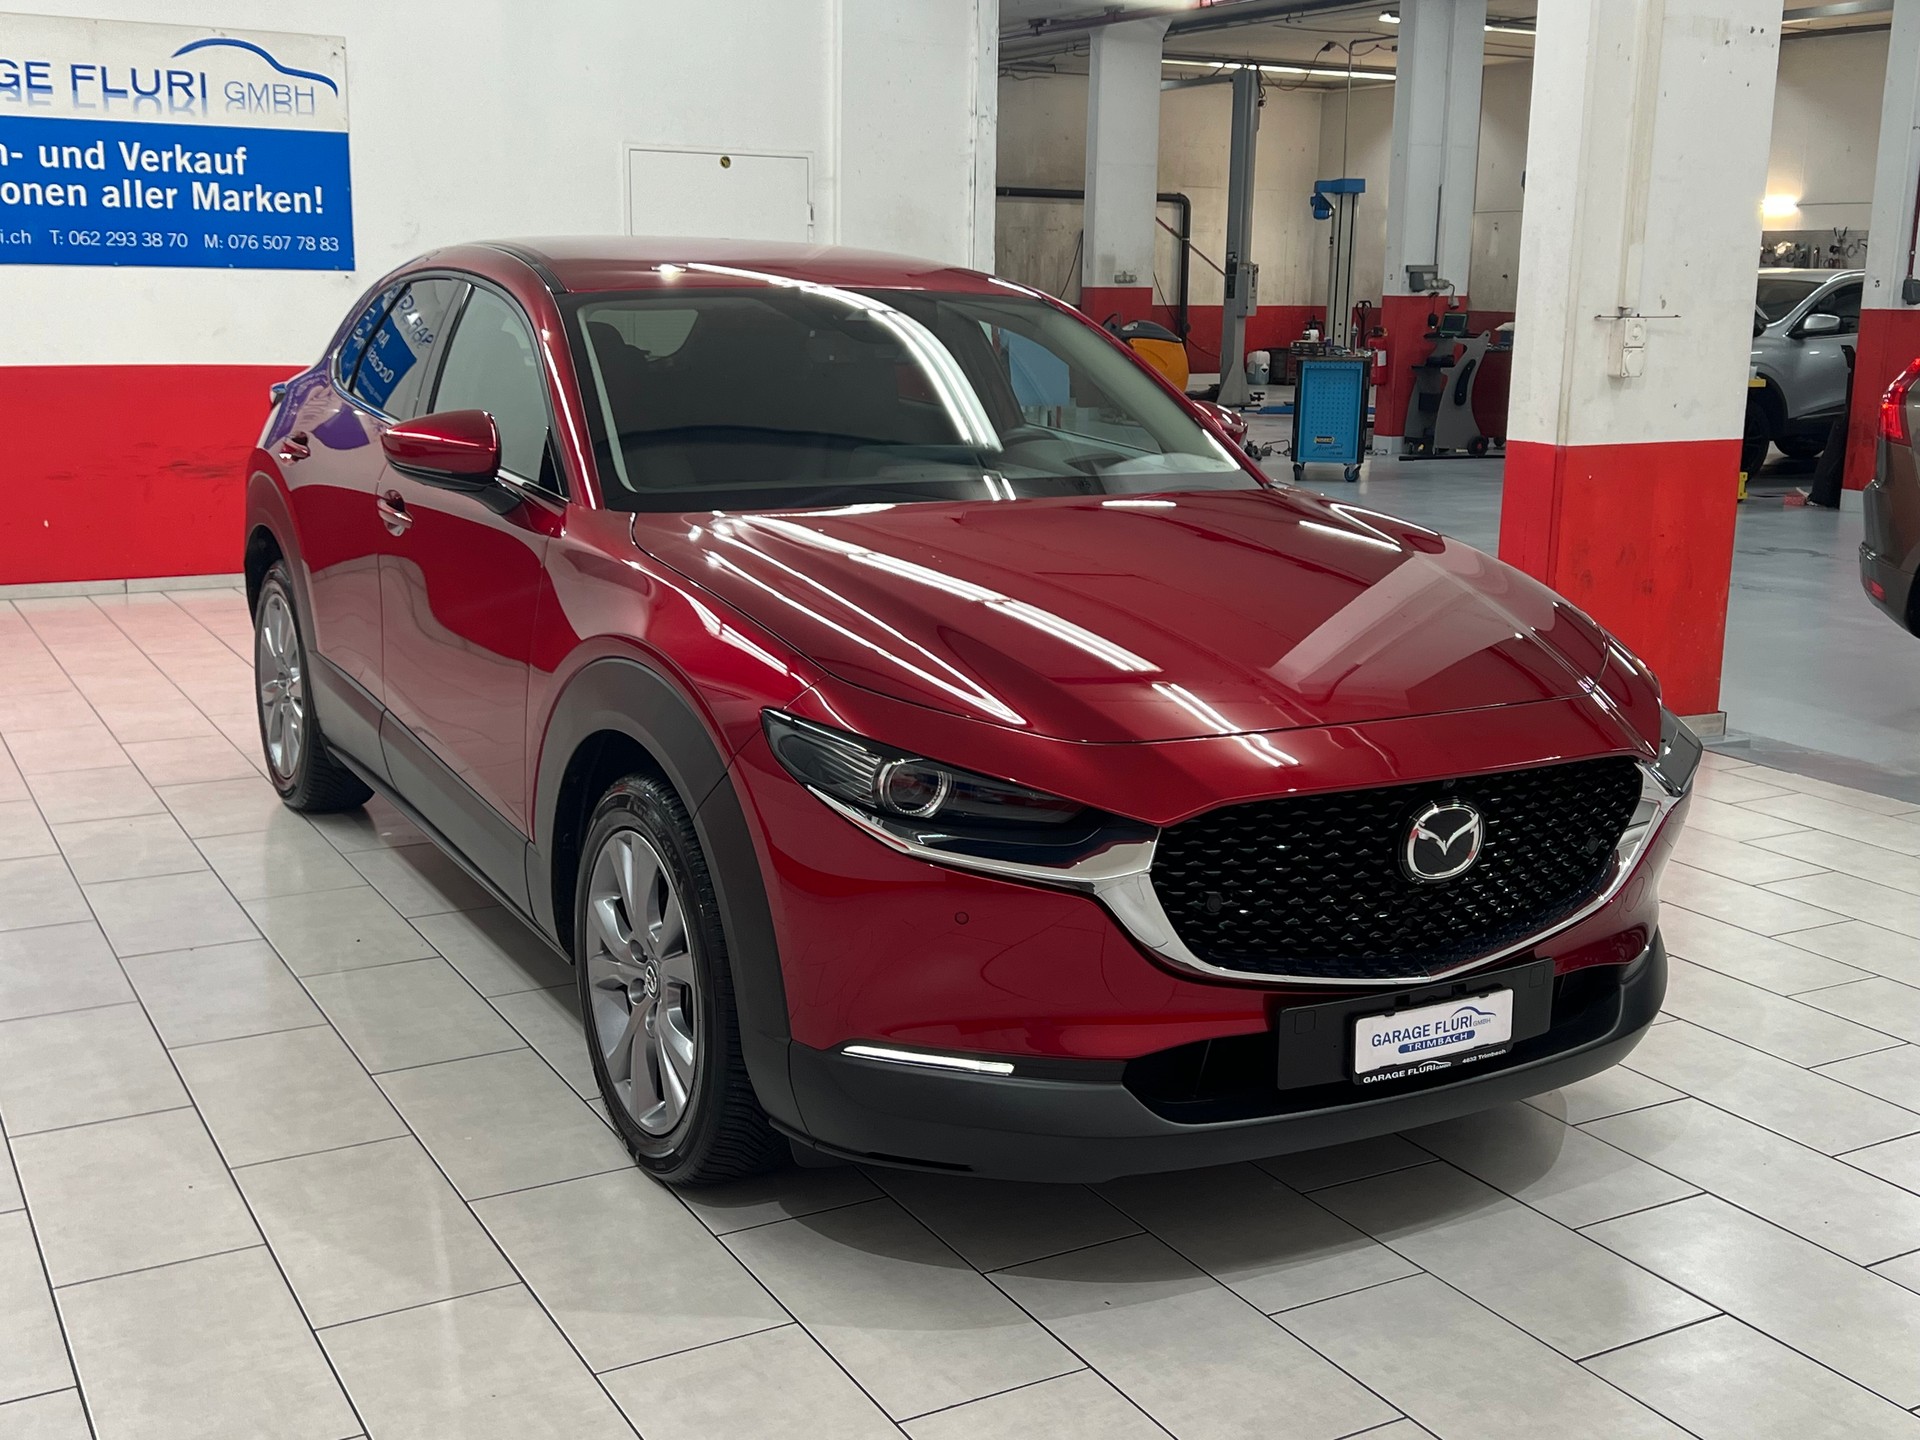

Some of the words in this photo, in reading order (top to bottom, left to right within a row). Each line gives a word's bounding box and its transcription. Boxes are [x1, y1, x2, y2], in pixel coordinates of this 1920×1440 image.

[70, 64, 208, 99] FLURI
[223, 80, 316, 102] GMBH
[38, 140, 106, 170] und
[118, 141, 248, 175] Verkauf
[0, 181, 88, 207] onen
[101, 178, 178, 209] aller
[191, 181, 324, 215] Marken!
[48, 229, 64, 246] T:
[68, 230, 101, 246] 062
[105, 231, 138, 247] 293
[141, 231, 164, 248] 38
[166, 232, 189, 248] 70
[203, 233, 224, 249] M:
[227, 234, 259, 250] 076
[262, 235, 292, 251] 507
[296, 235, 317, 251] 78
[319, 236, 340, 252] 83
[1371, 1024, 1431, 1047] GARAGE
[1434, 1014, 1472, 1035] FLURI
[1407, 1032, 1468, 1052] TRIMBACH
[1363, 1070, 1406, 1084] GARAGE
[1407, 1064, 1436, 1076] FLURI
[1478, 1049, 1507, 1060] Trimbach
